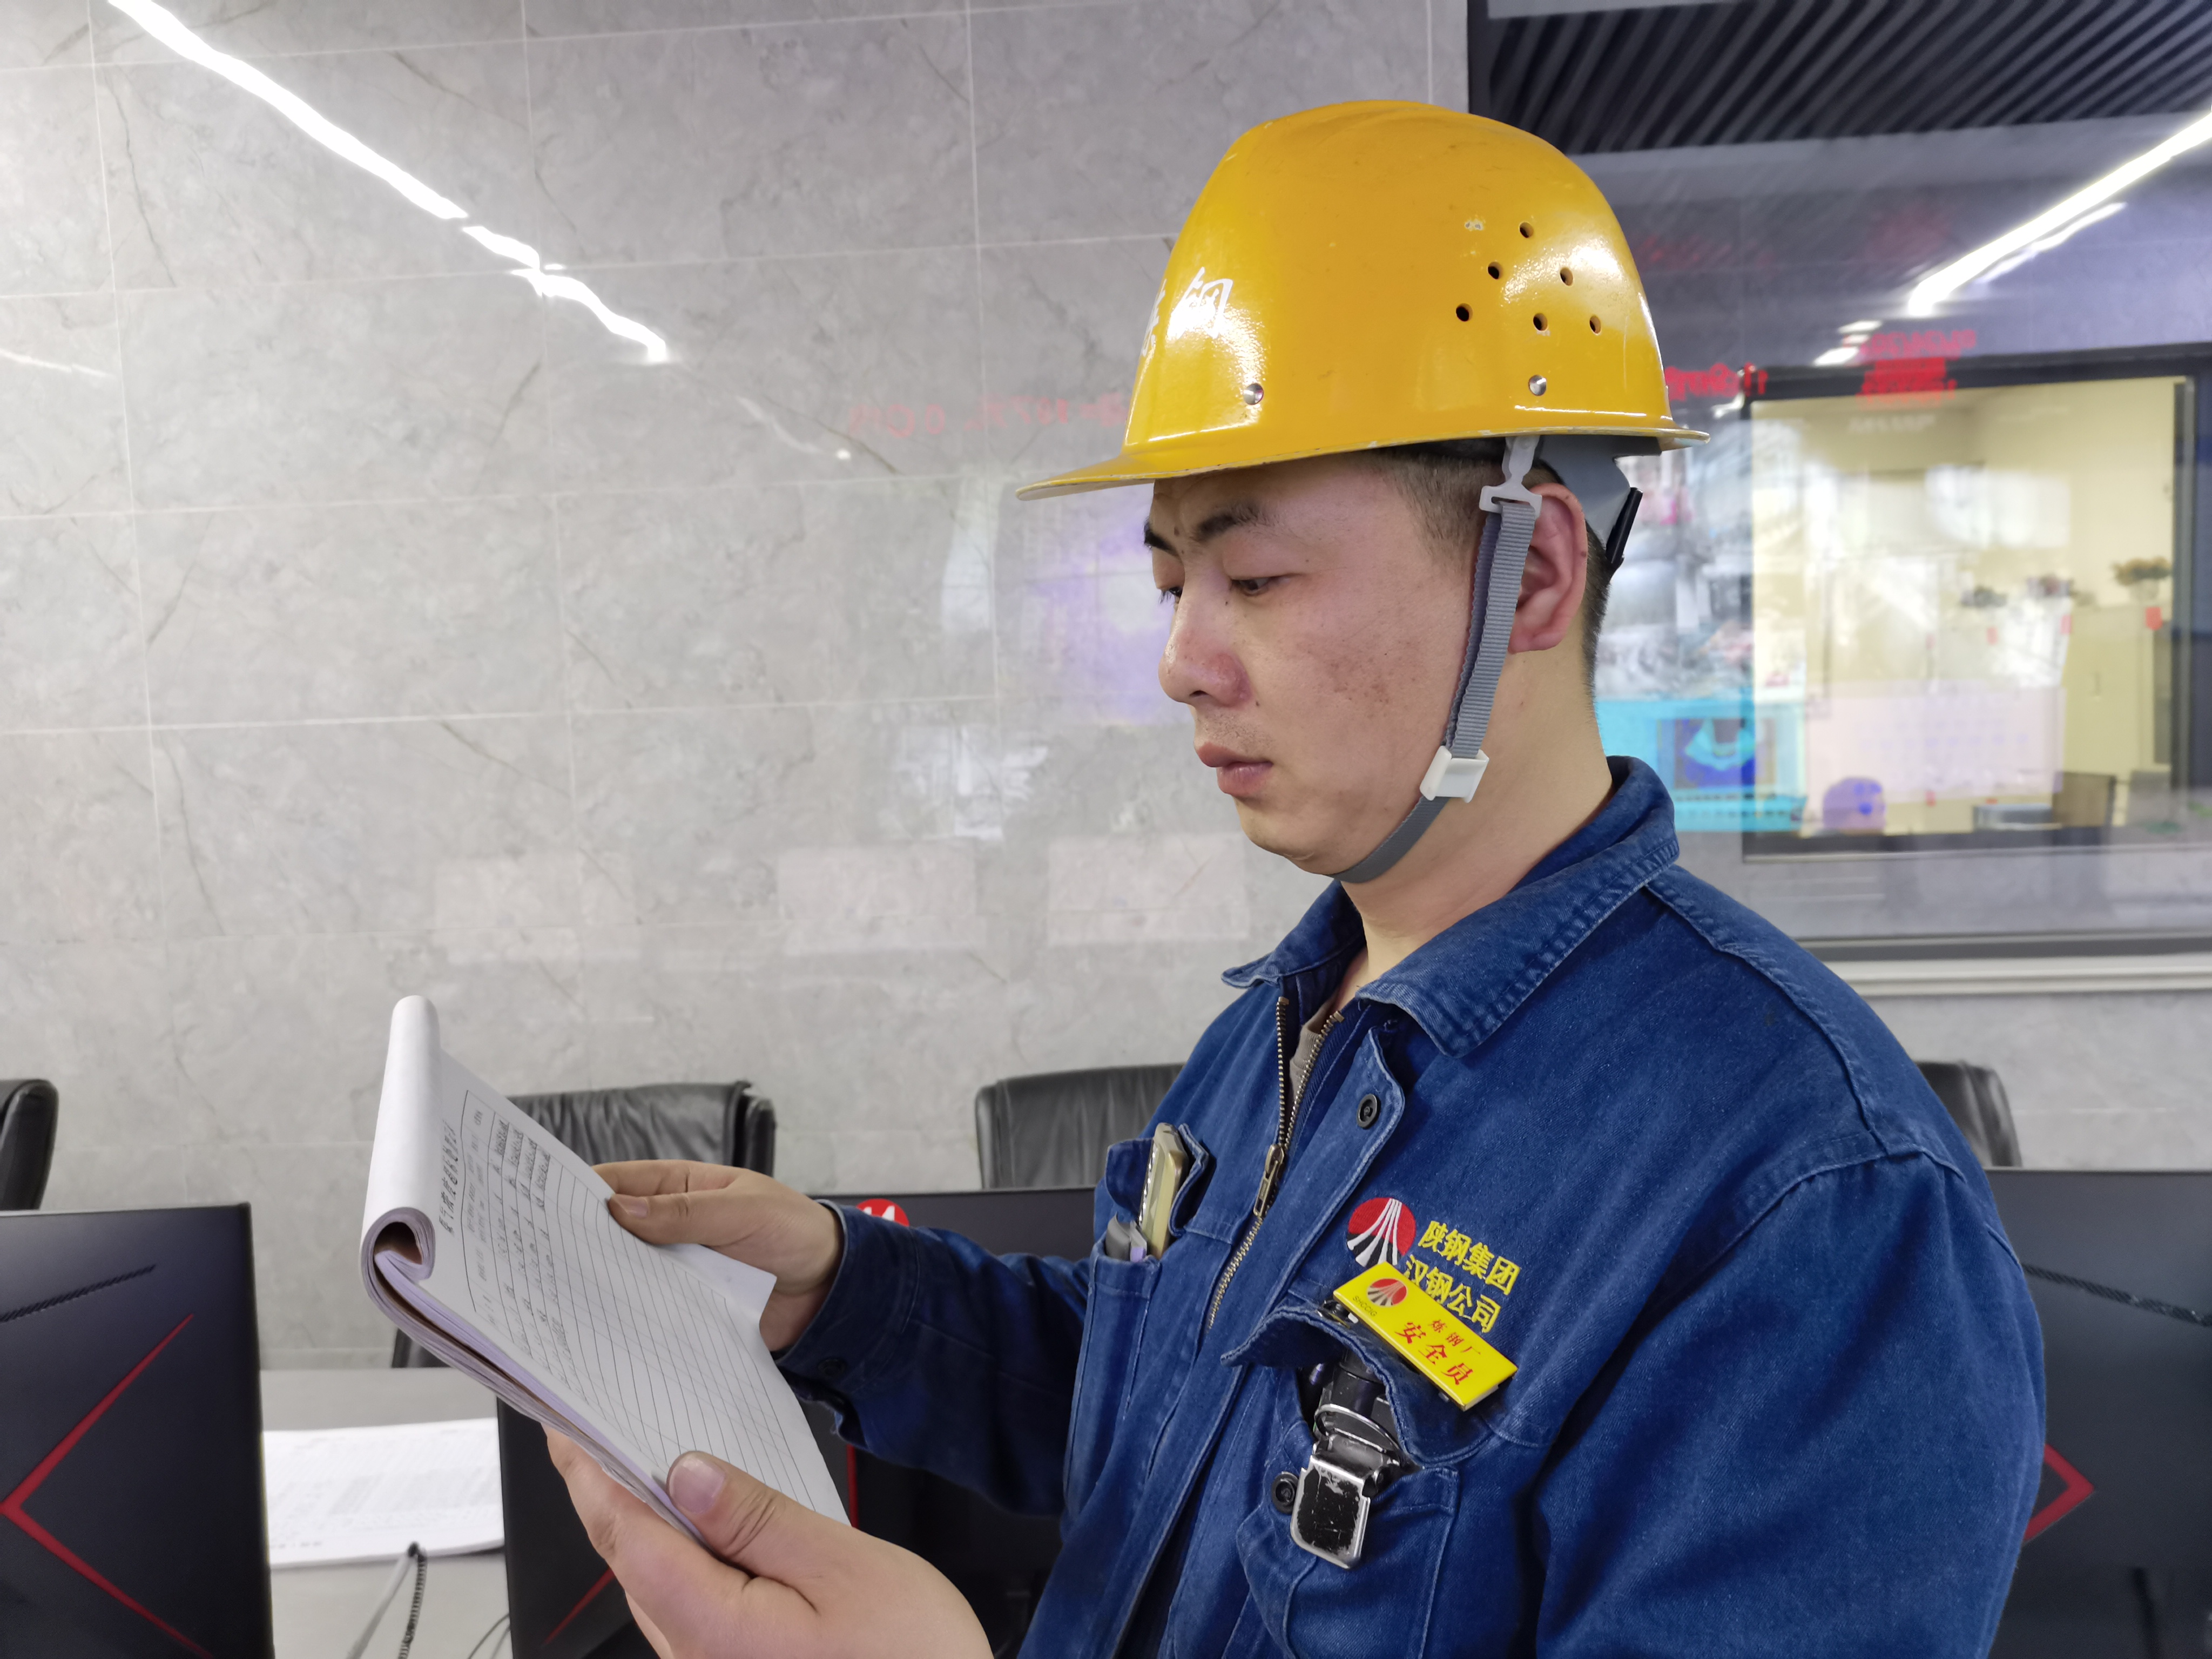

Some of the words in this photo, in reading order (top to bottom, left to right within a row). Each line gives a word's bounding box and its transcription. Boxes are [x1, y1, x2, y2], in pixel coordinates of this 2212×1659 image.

[1418, 1220, 1521, 1296] 陕钢集团
[1352, 1295, 1378, 1317] SHCCIG
[1404, 1254, 1501, 1333] 汉钢公司
[1394, 1321, 1473, 1386] 安全员
[1428, 1319, 1481, 1355] 炼钢厂
